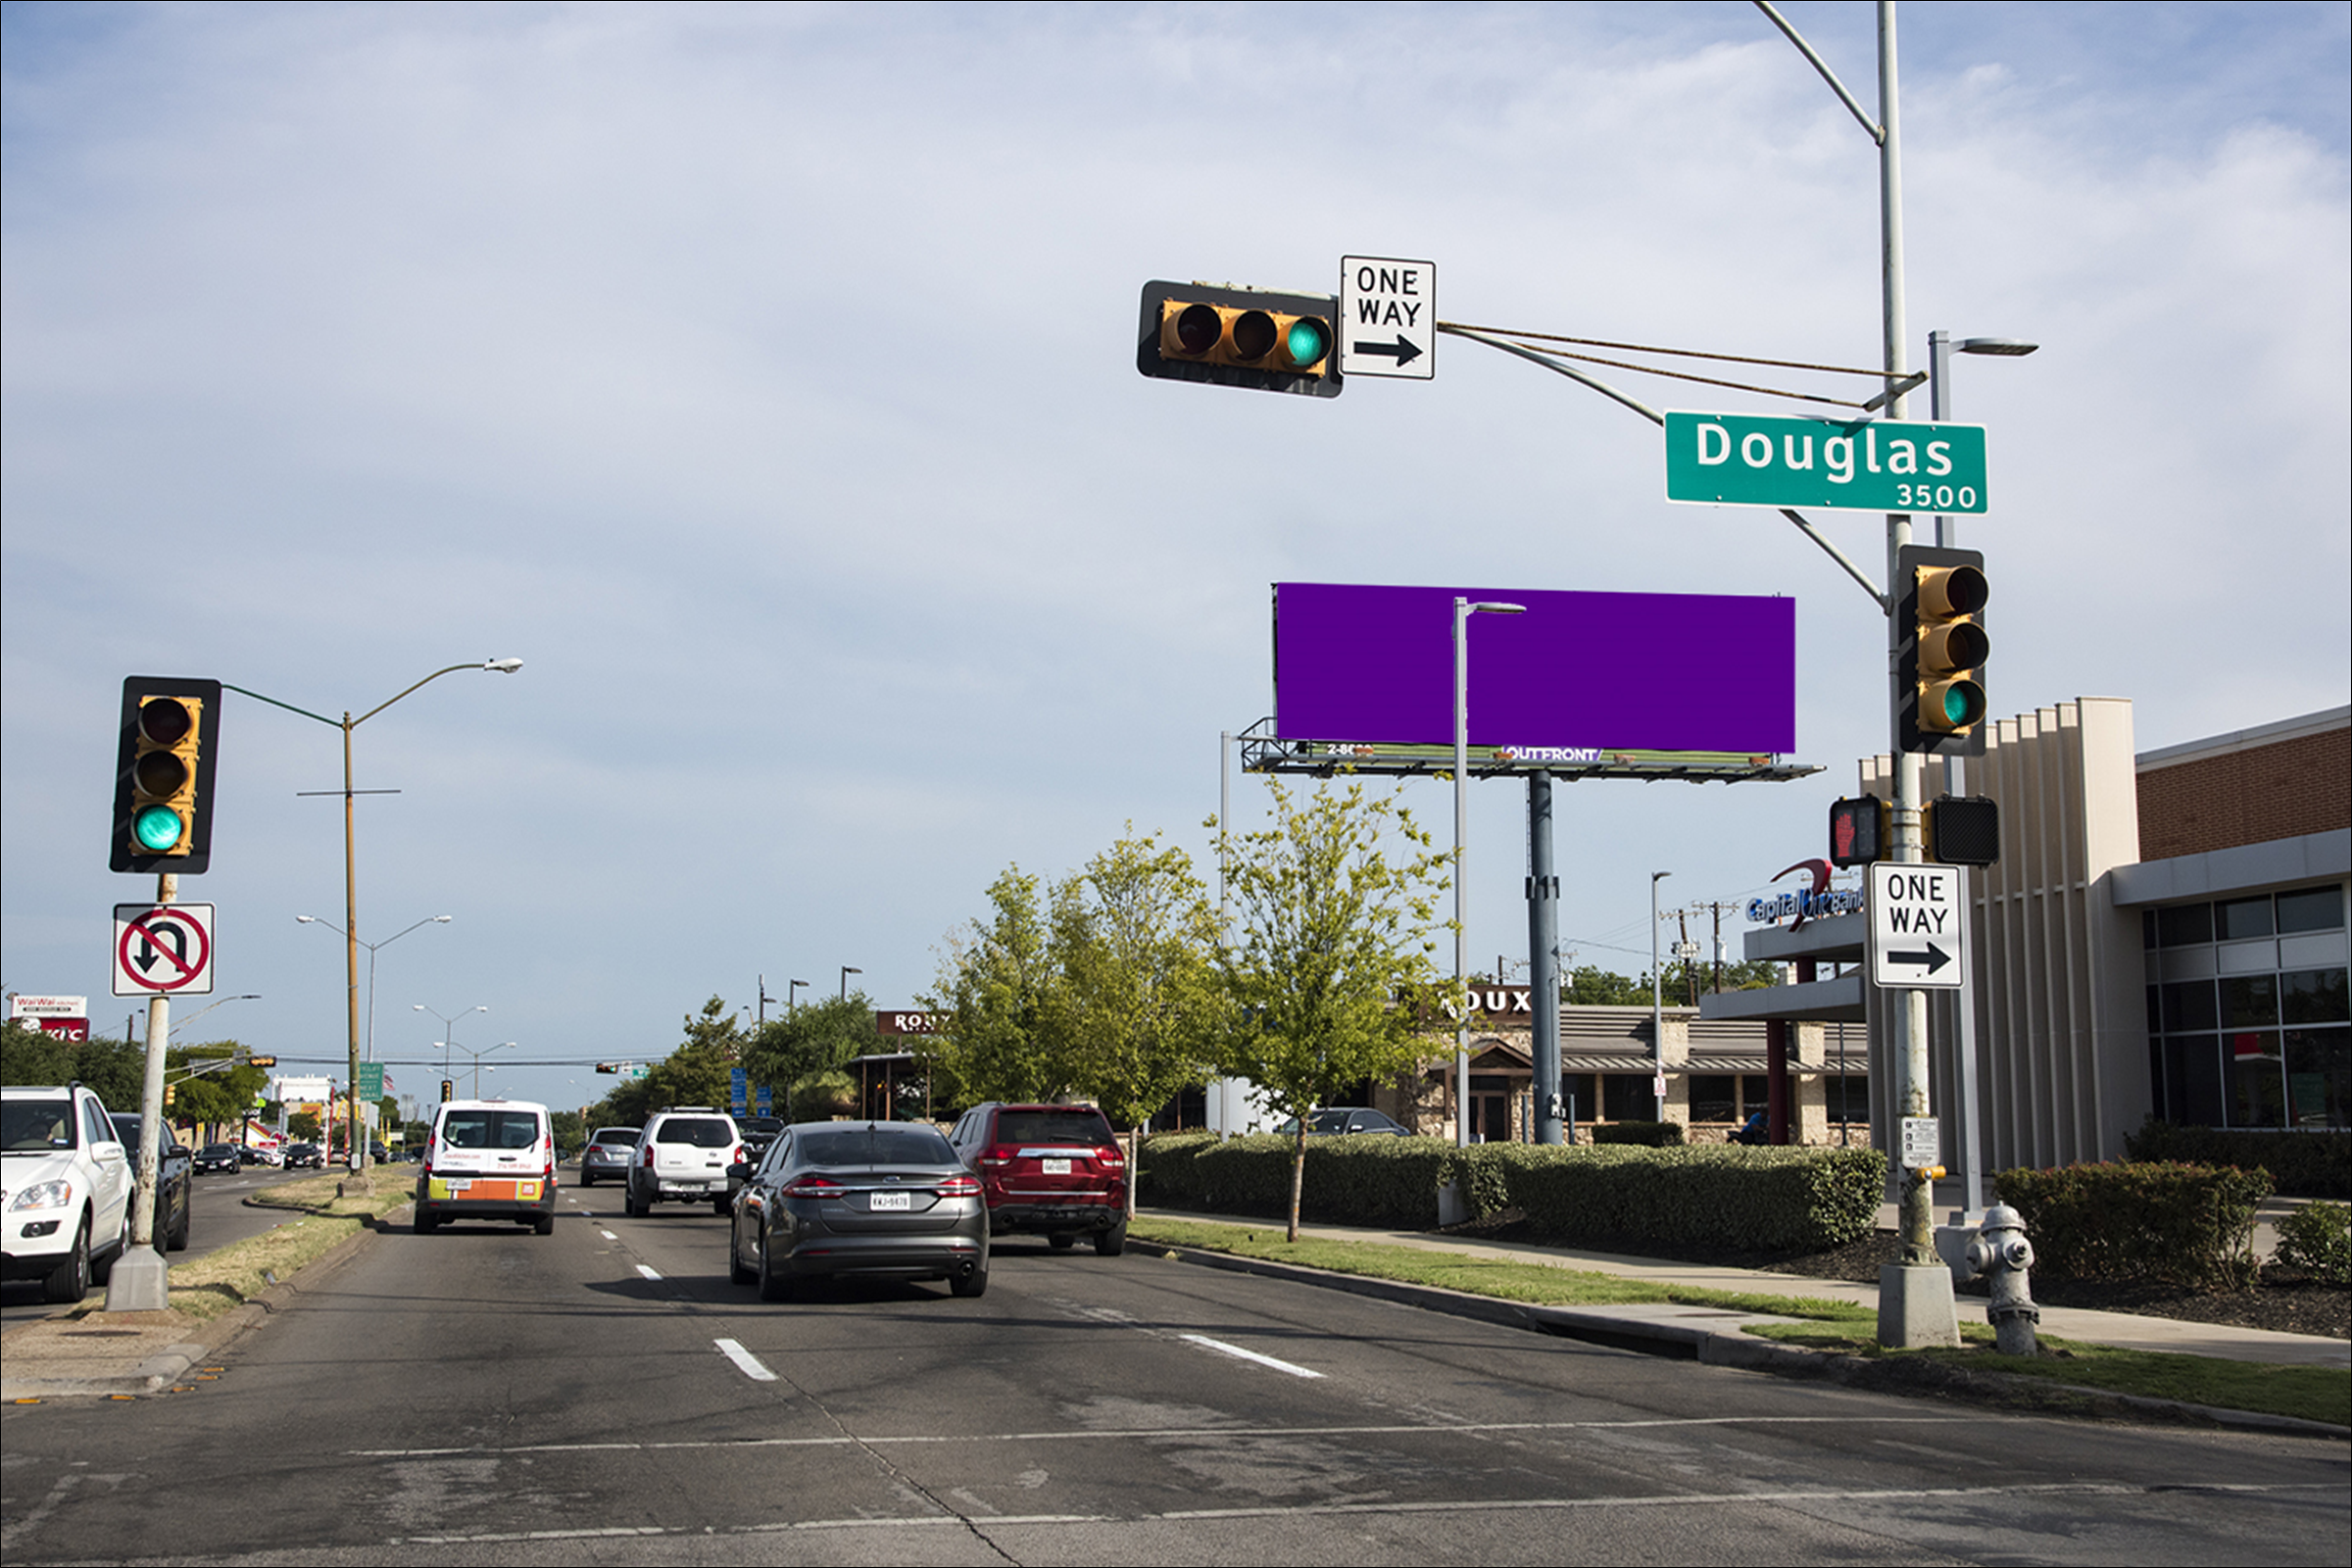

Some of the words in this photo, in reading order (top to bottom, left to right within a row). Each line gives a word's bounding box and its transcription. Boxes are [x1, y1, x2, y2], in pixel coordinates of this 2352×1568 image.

[1357, 267, 1418, 295] ONE
[1358, 298, 1421, 327] WAY
[1696, 422, 1953, 484] Douglas
[1896, 483, 1977, 509] 3500
[1887, 873, 1944, 902] ONE
[1889, 907, 1948, 934] WAY
